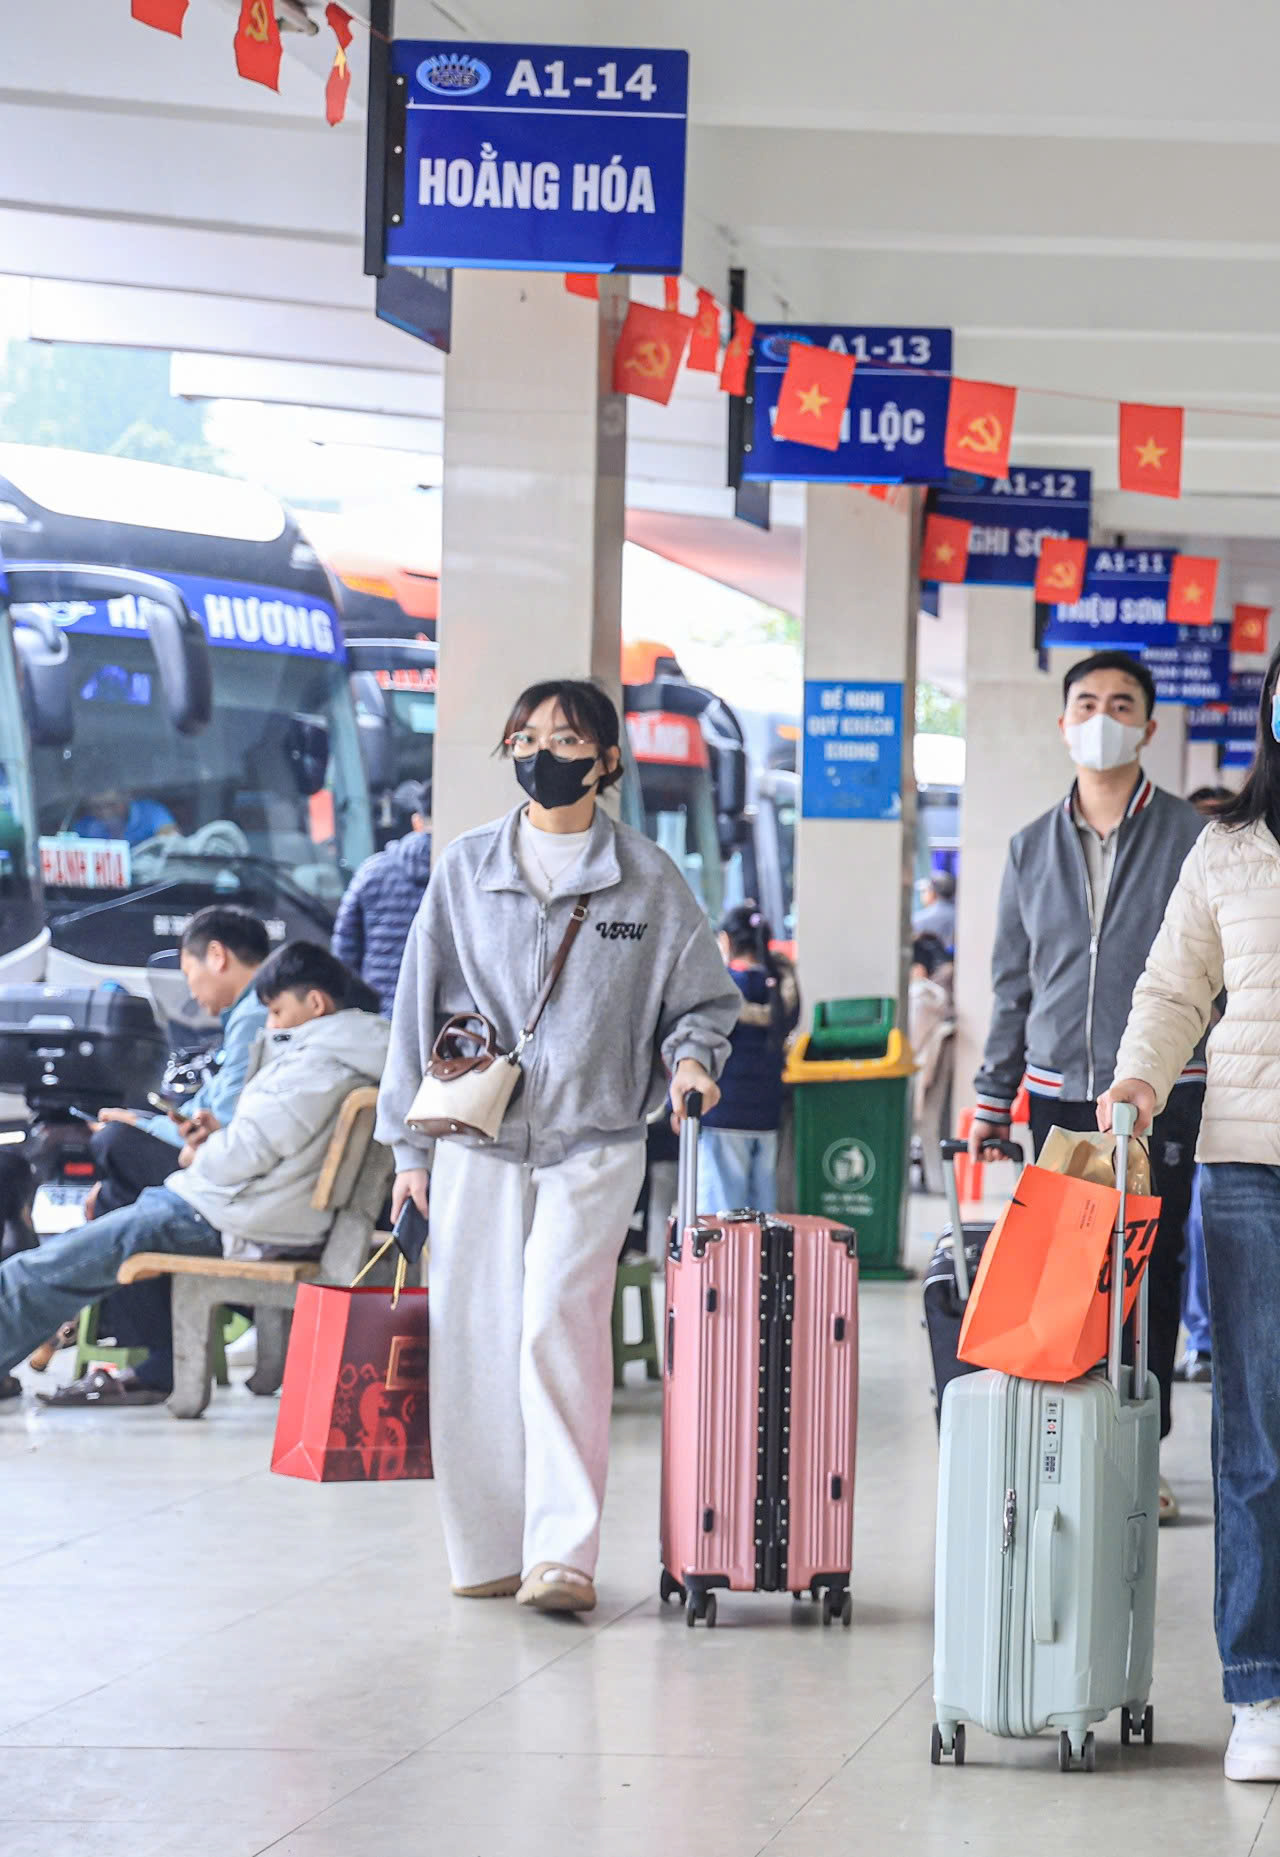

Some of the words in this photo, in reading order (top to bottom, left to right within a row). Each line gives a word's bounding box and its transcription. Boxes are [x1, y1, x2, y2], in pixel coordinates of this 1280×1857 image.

[505, 58, 657, 101] A1-14
[418, 141, 560, 211] HOẰNG
[571, 154, 656, 214] HÓA
[827, 333, 932, 365] A1-13
[859, 400, 926, 451] LỘC
[992, 472, 1077, 499] A1-12
[968, 525, 1011, 556] GHI
